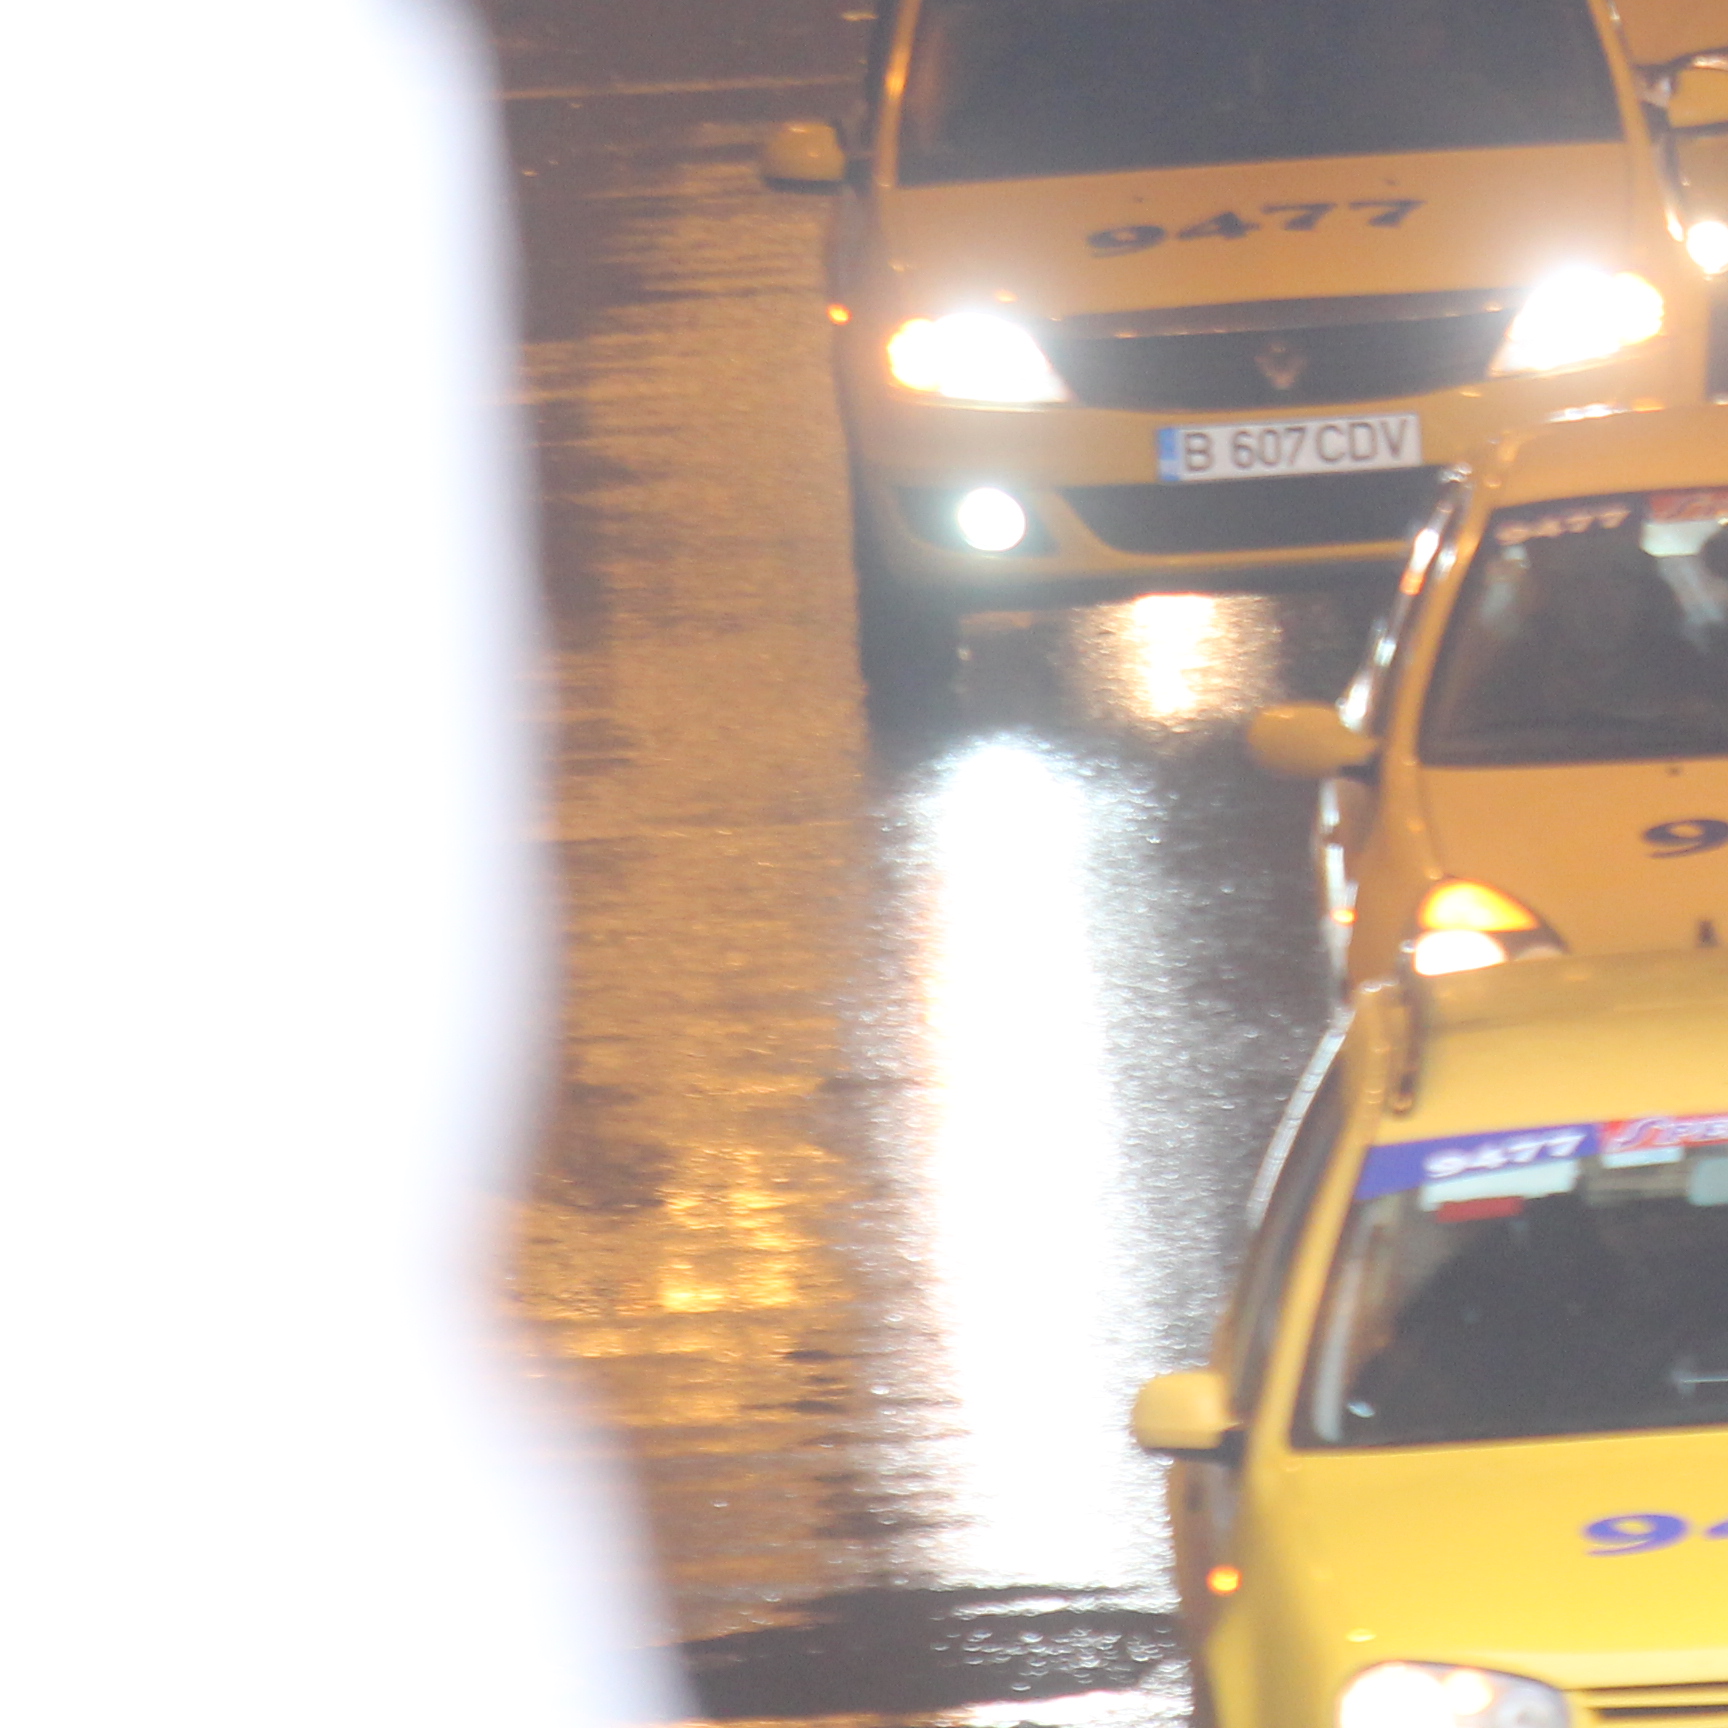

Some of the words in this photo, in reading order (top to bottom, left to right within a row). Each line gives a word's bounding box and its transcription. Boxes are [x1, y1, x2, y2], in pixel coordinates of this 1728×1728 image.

[1087, 198, 1427, 259] 9477
[1184, 432, 1213, 472] B
[1231, 426, 1306, 469] 607
[1315, 418, 1407, 463] CDV
[1498, 508, 1631, 547] 9477
[1425, 1130, 1586, 1181] 9477
